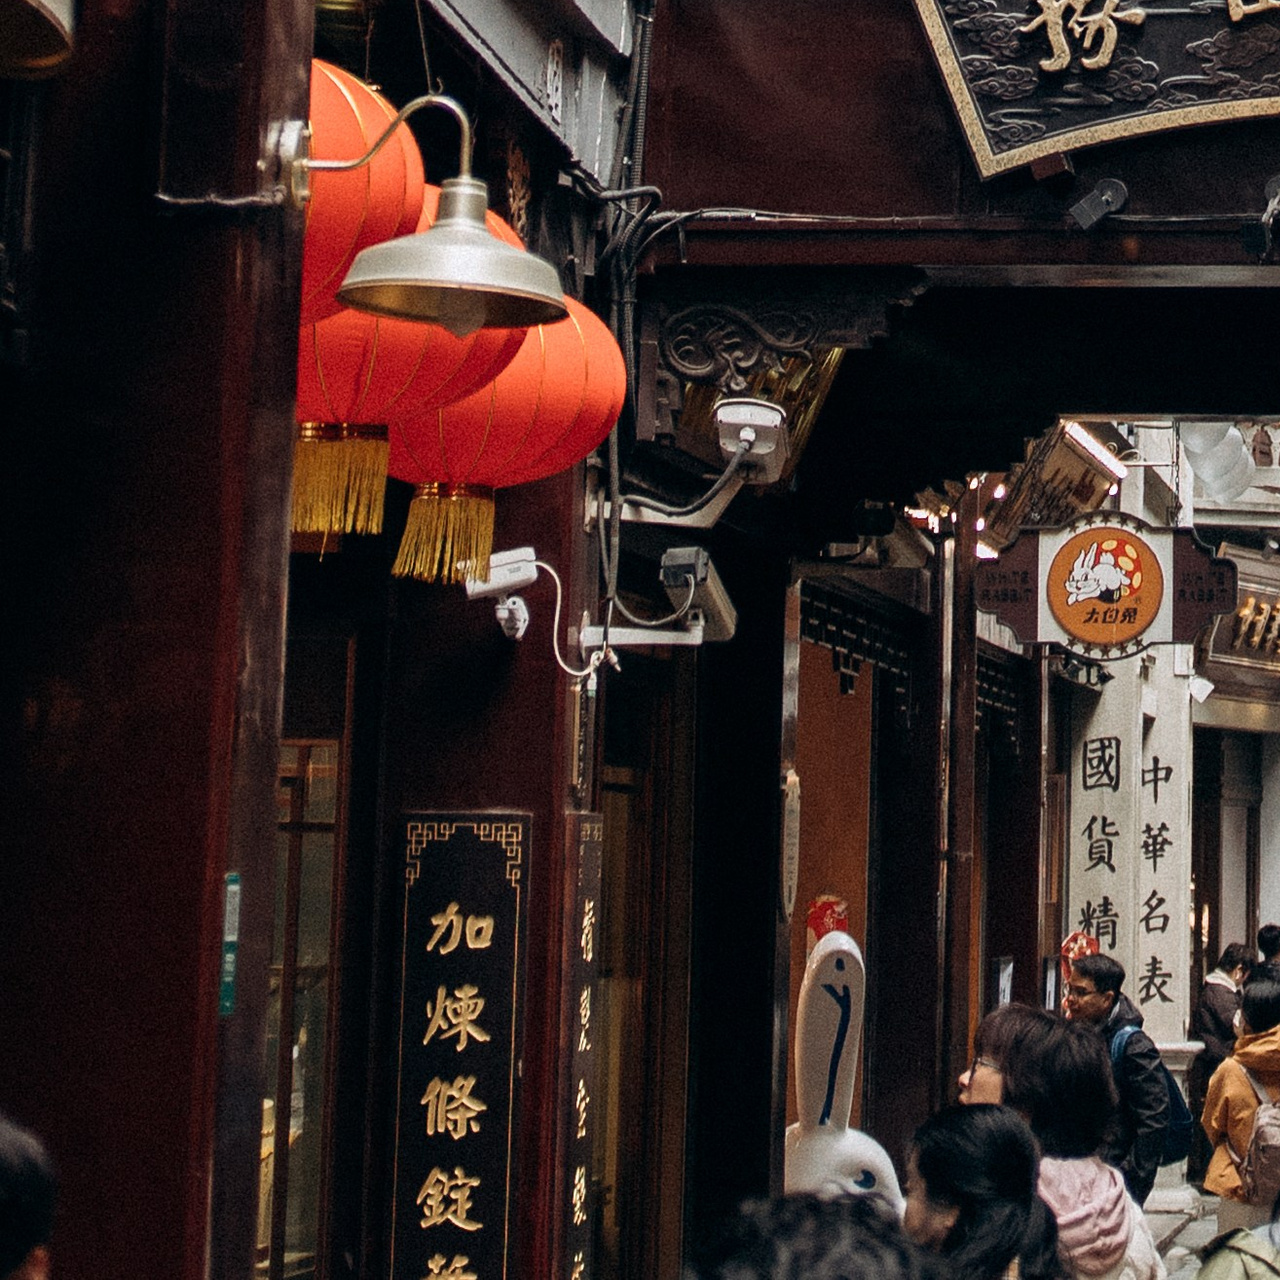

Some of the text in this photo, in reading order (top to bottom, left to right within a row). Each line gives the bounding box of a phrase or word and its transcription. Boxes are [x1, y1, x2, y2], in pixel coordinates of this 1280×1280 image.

[1079, 736, 1121, 951] 國貨精
[1138, 756, 1174, 1006] 中華名表
